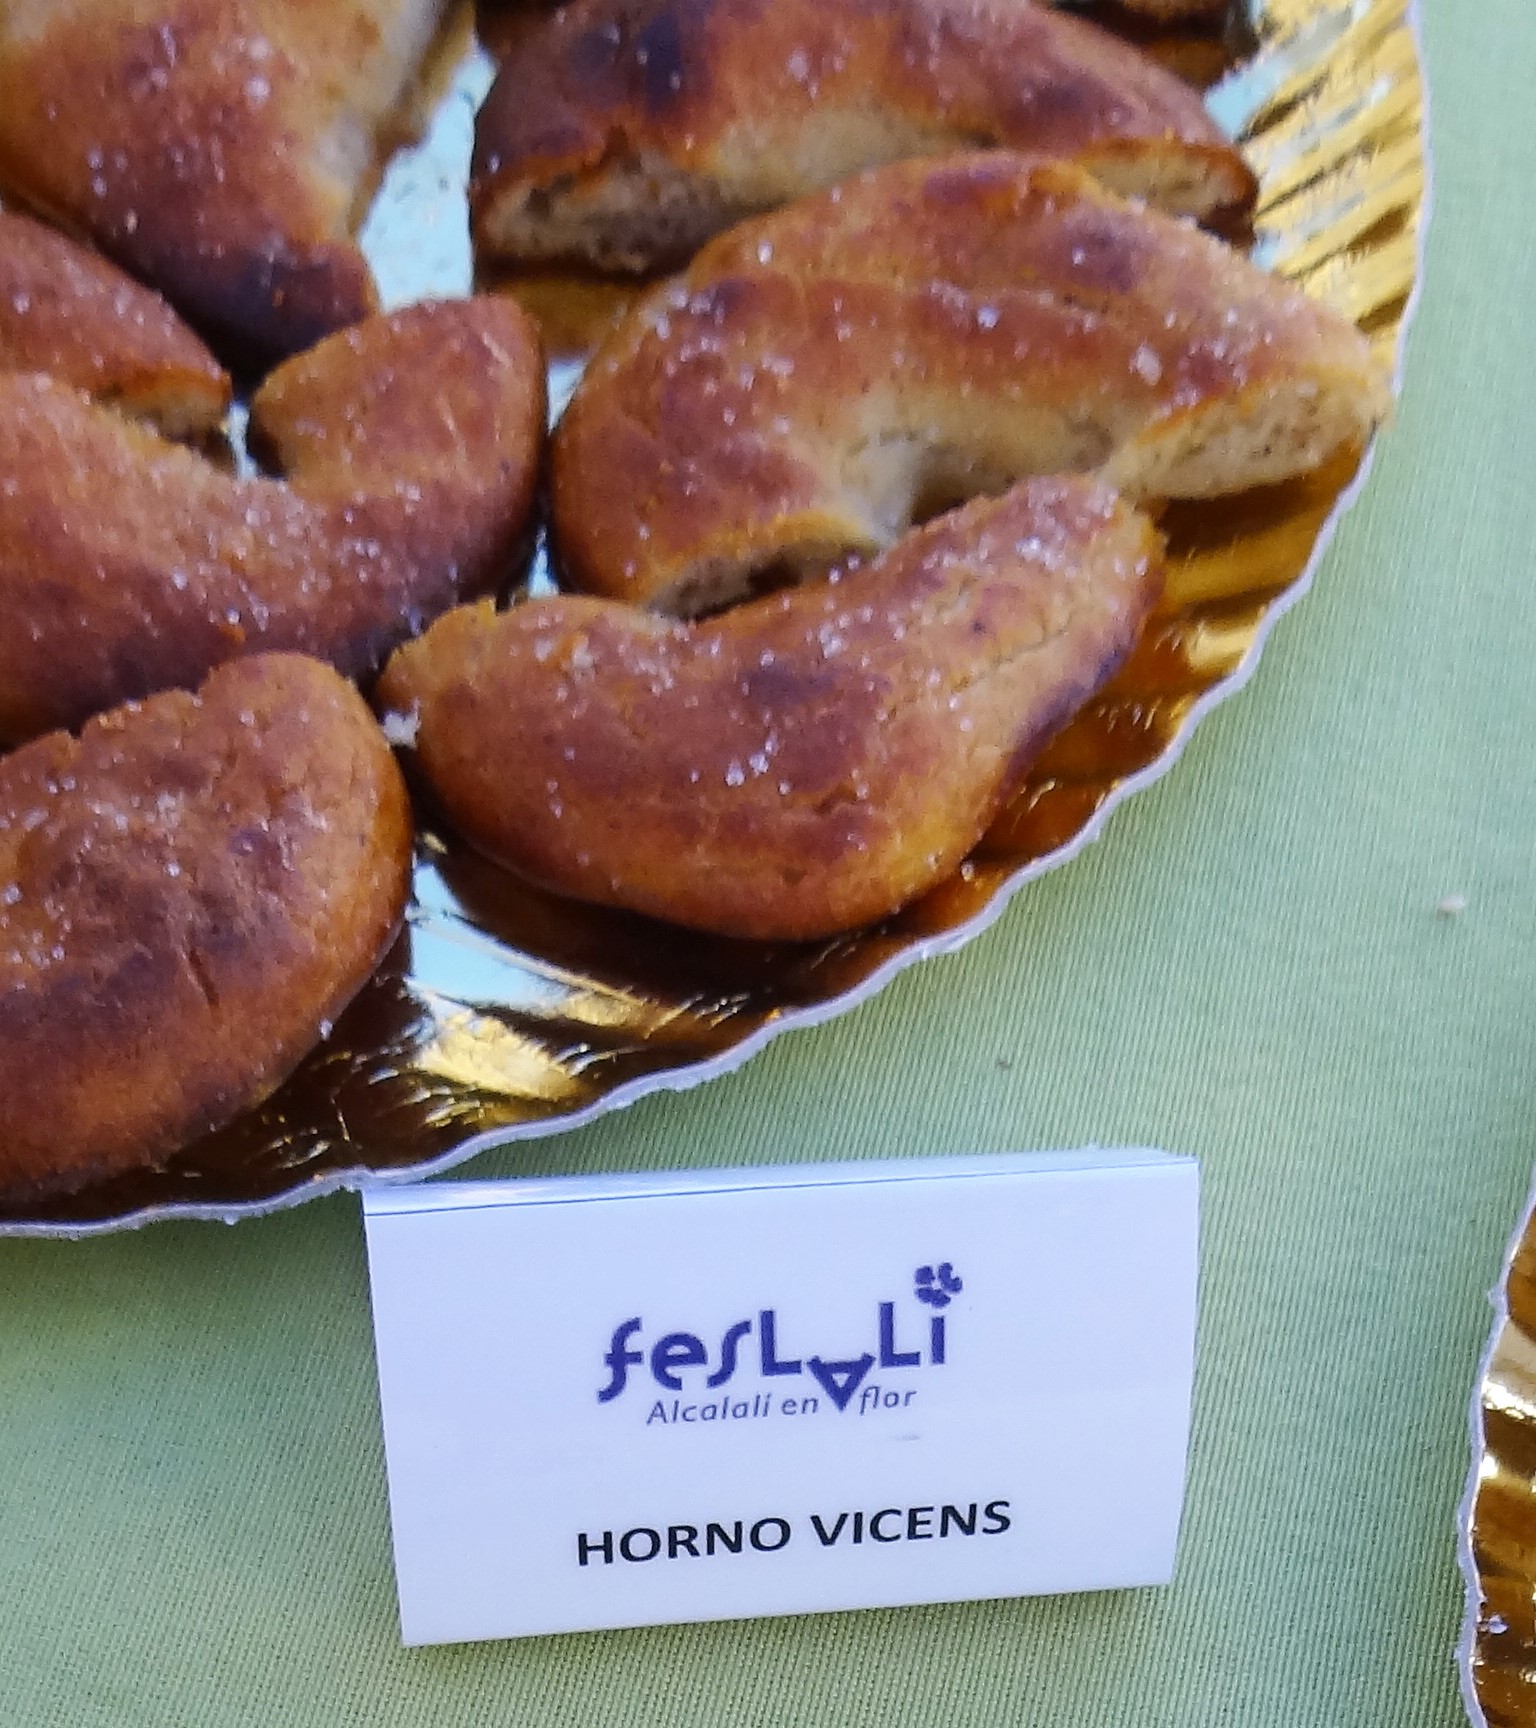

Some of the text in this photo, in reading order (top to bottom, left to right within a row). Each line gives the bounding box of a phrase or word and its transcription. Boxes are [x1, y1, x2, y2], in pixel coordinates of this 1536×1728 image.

[781, 1396, 819, 1416] en
[859, 1385, 918, 1416] flor
[577, 1500, 1012, 1567] HORNO VICENS
